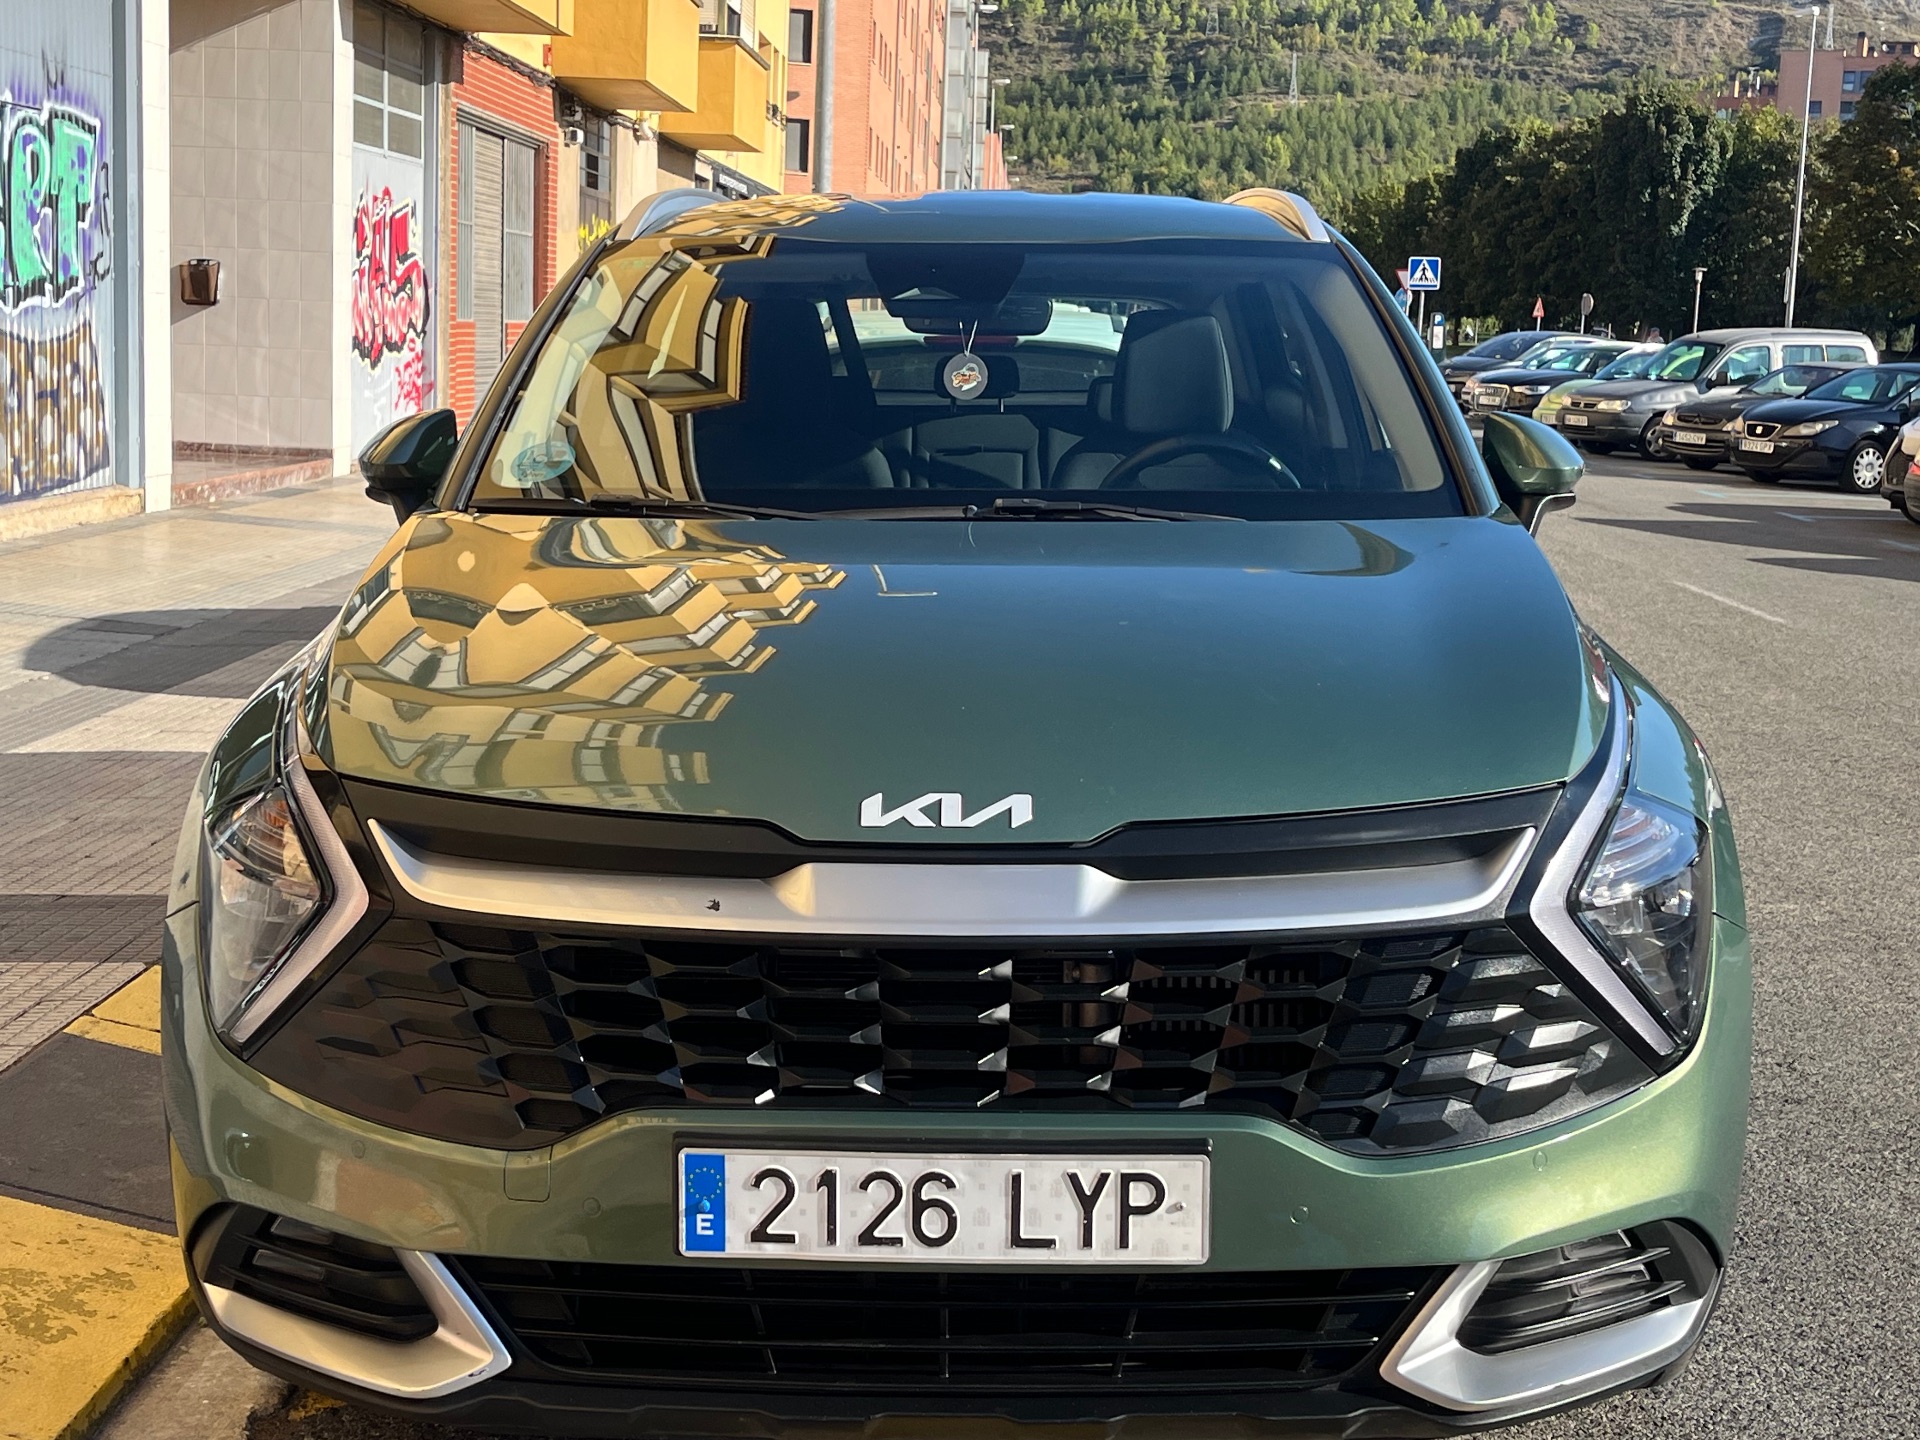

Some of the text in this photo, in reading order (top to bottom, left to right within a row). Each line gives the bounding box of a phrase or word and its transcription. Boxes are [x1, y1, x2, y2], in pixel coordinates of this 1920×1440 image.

[1434, 314, 1442, 325] P
[860, 792, 1033, 829] KIA
[749, 1167, 1168, 1250] 2126 LYP
[695, 1213, 715, 1236] E
